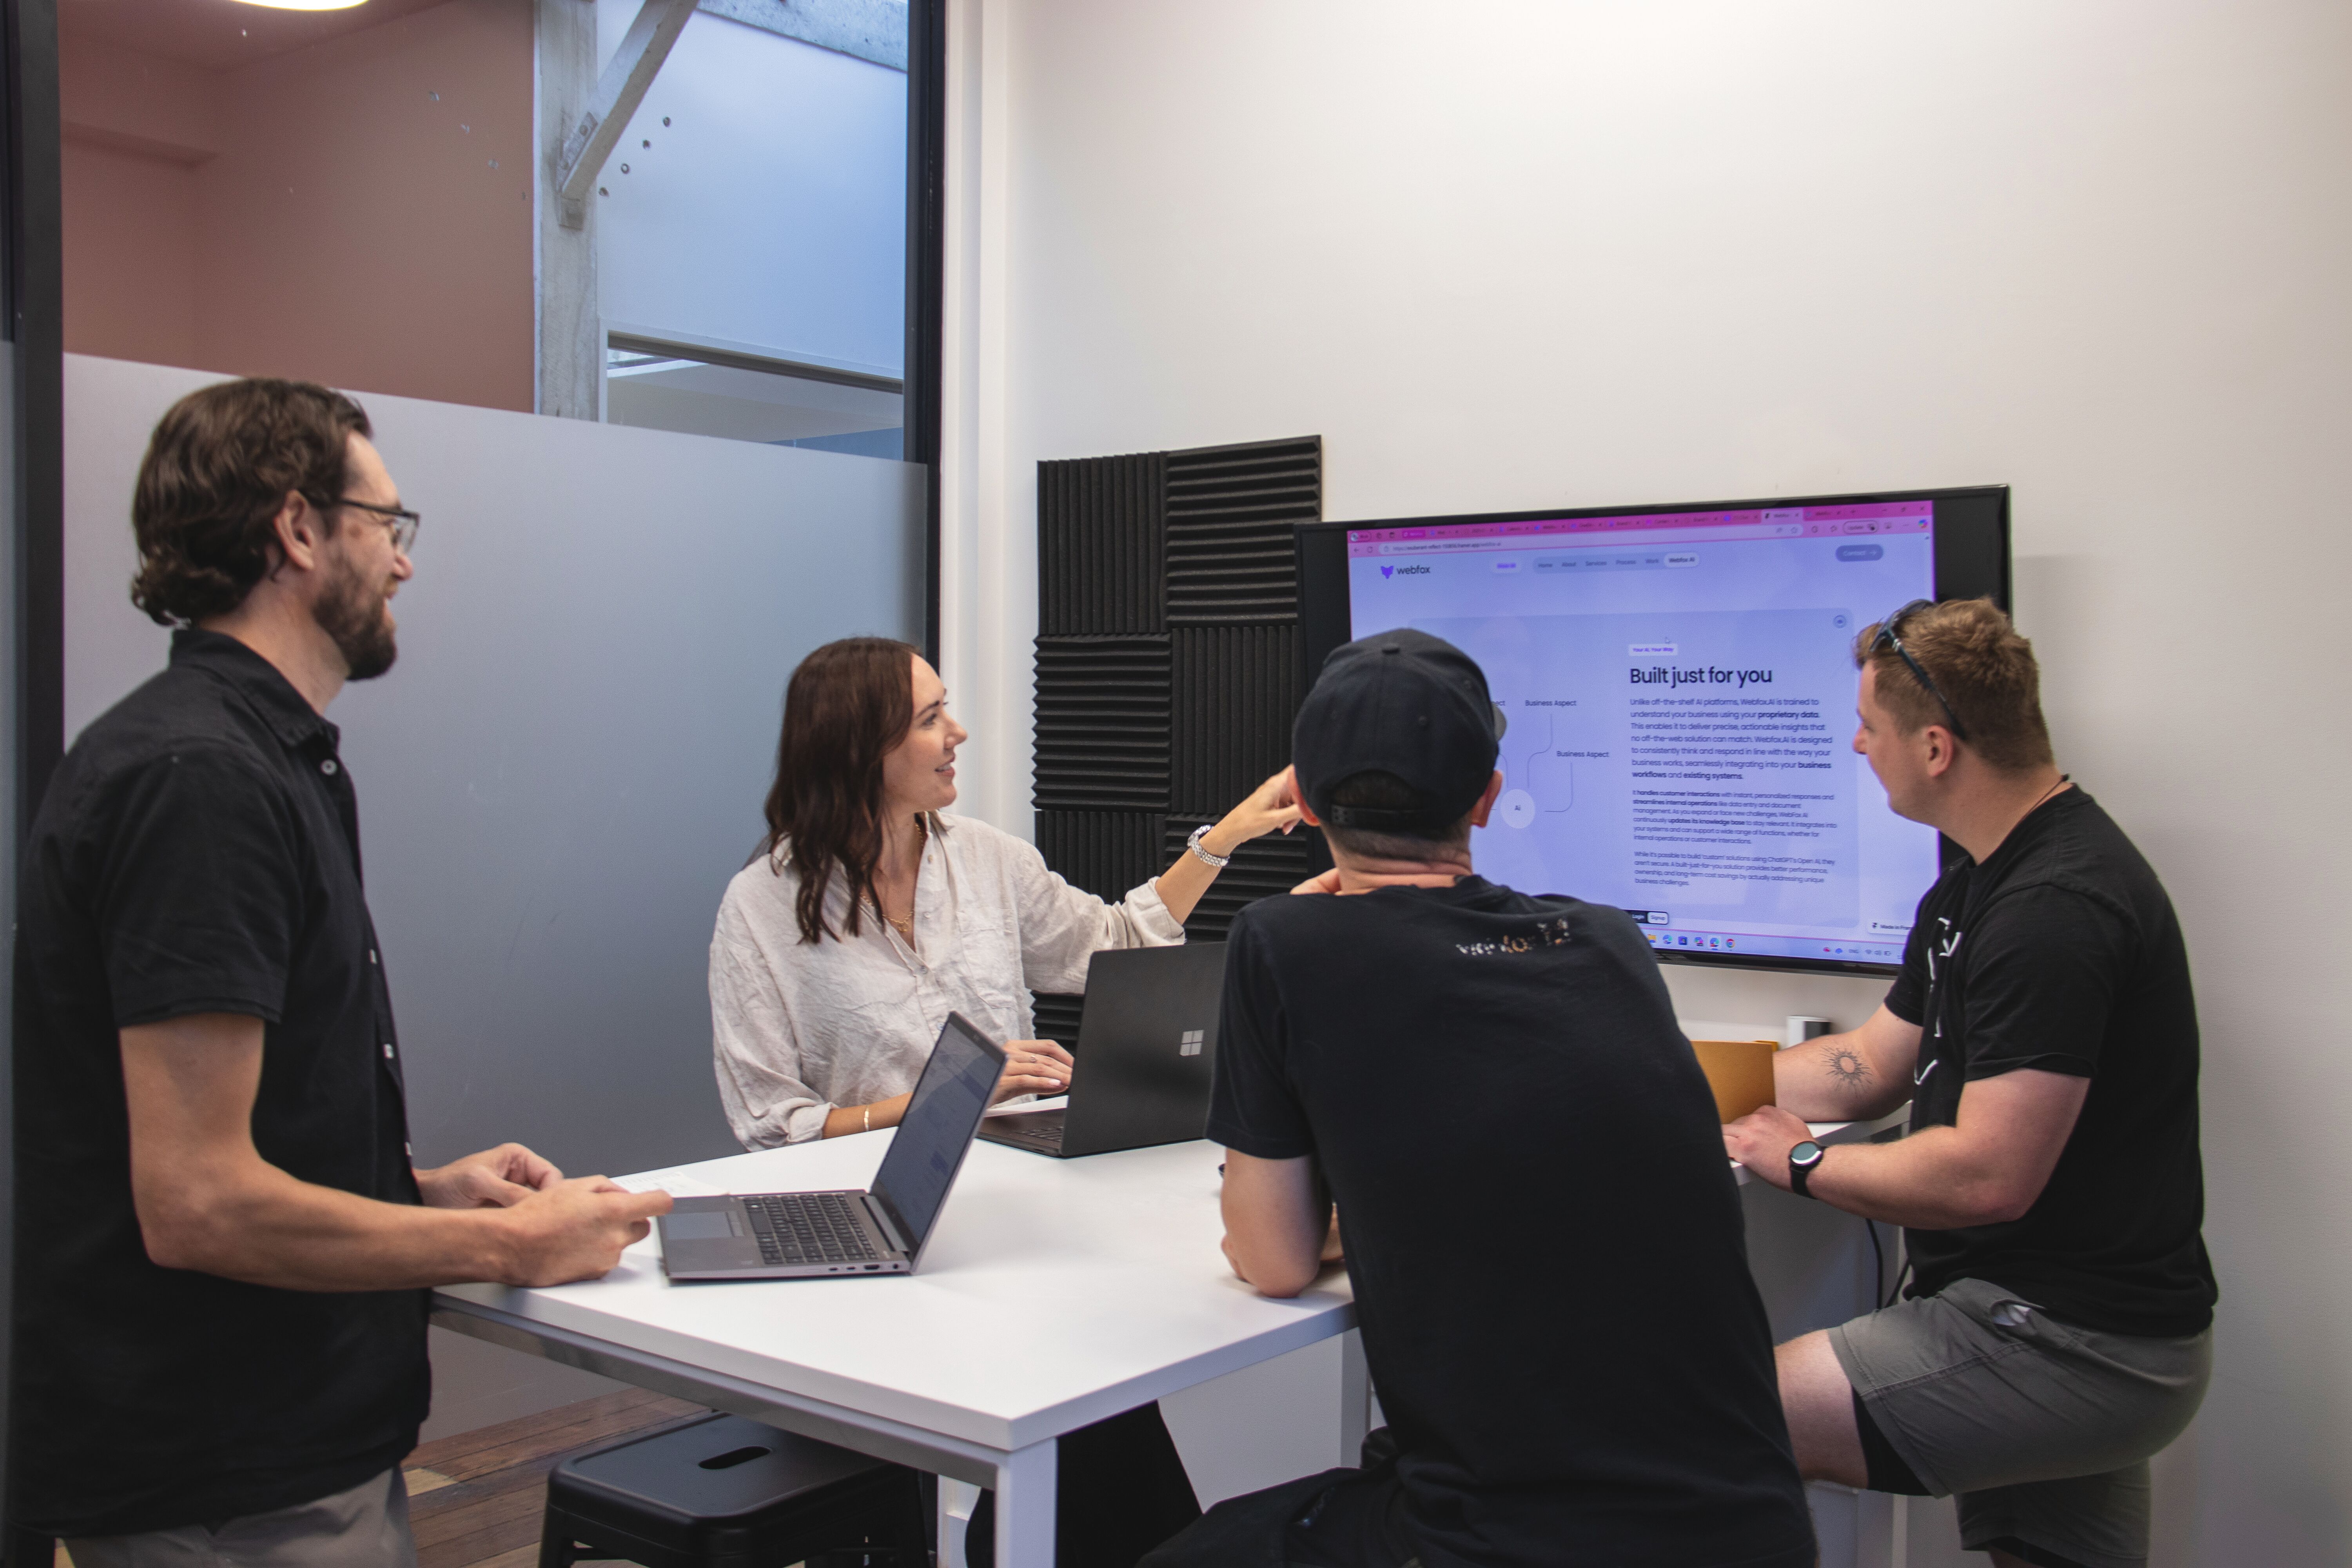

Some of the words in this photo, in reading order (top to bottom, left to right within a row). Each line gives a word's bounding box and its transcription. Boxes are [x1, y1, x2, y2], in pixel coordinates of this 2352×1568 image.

[1396, 565, 1430, 574] webfox
[1630, 667, 1668, 683] Built
[1671, 667, 1705, 688] just
[1708, 666, 1733, 683] for
[1737, 670, 1772, 688] you
[1757, 711, 1799, 720] proprietary
[1798, 737, 1832, 745] designed
[1640, 748, 1679, 756] consistently
[1715, 748, 1744, 757] respond
[1685, 760, 1723, 768] seamlessly
[1725, 760, 1764, 769] integrating
